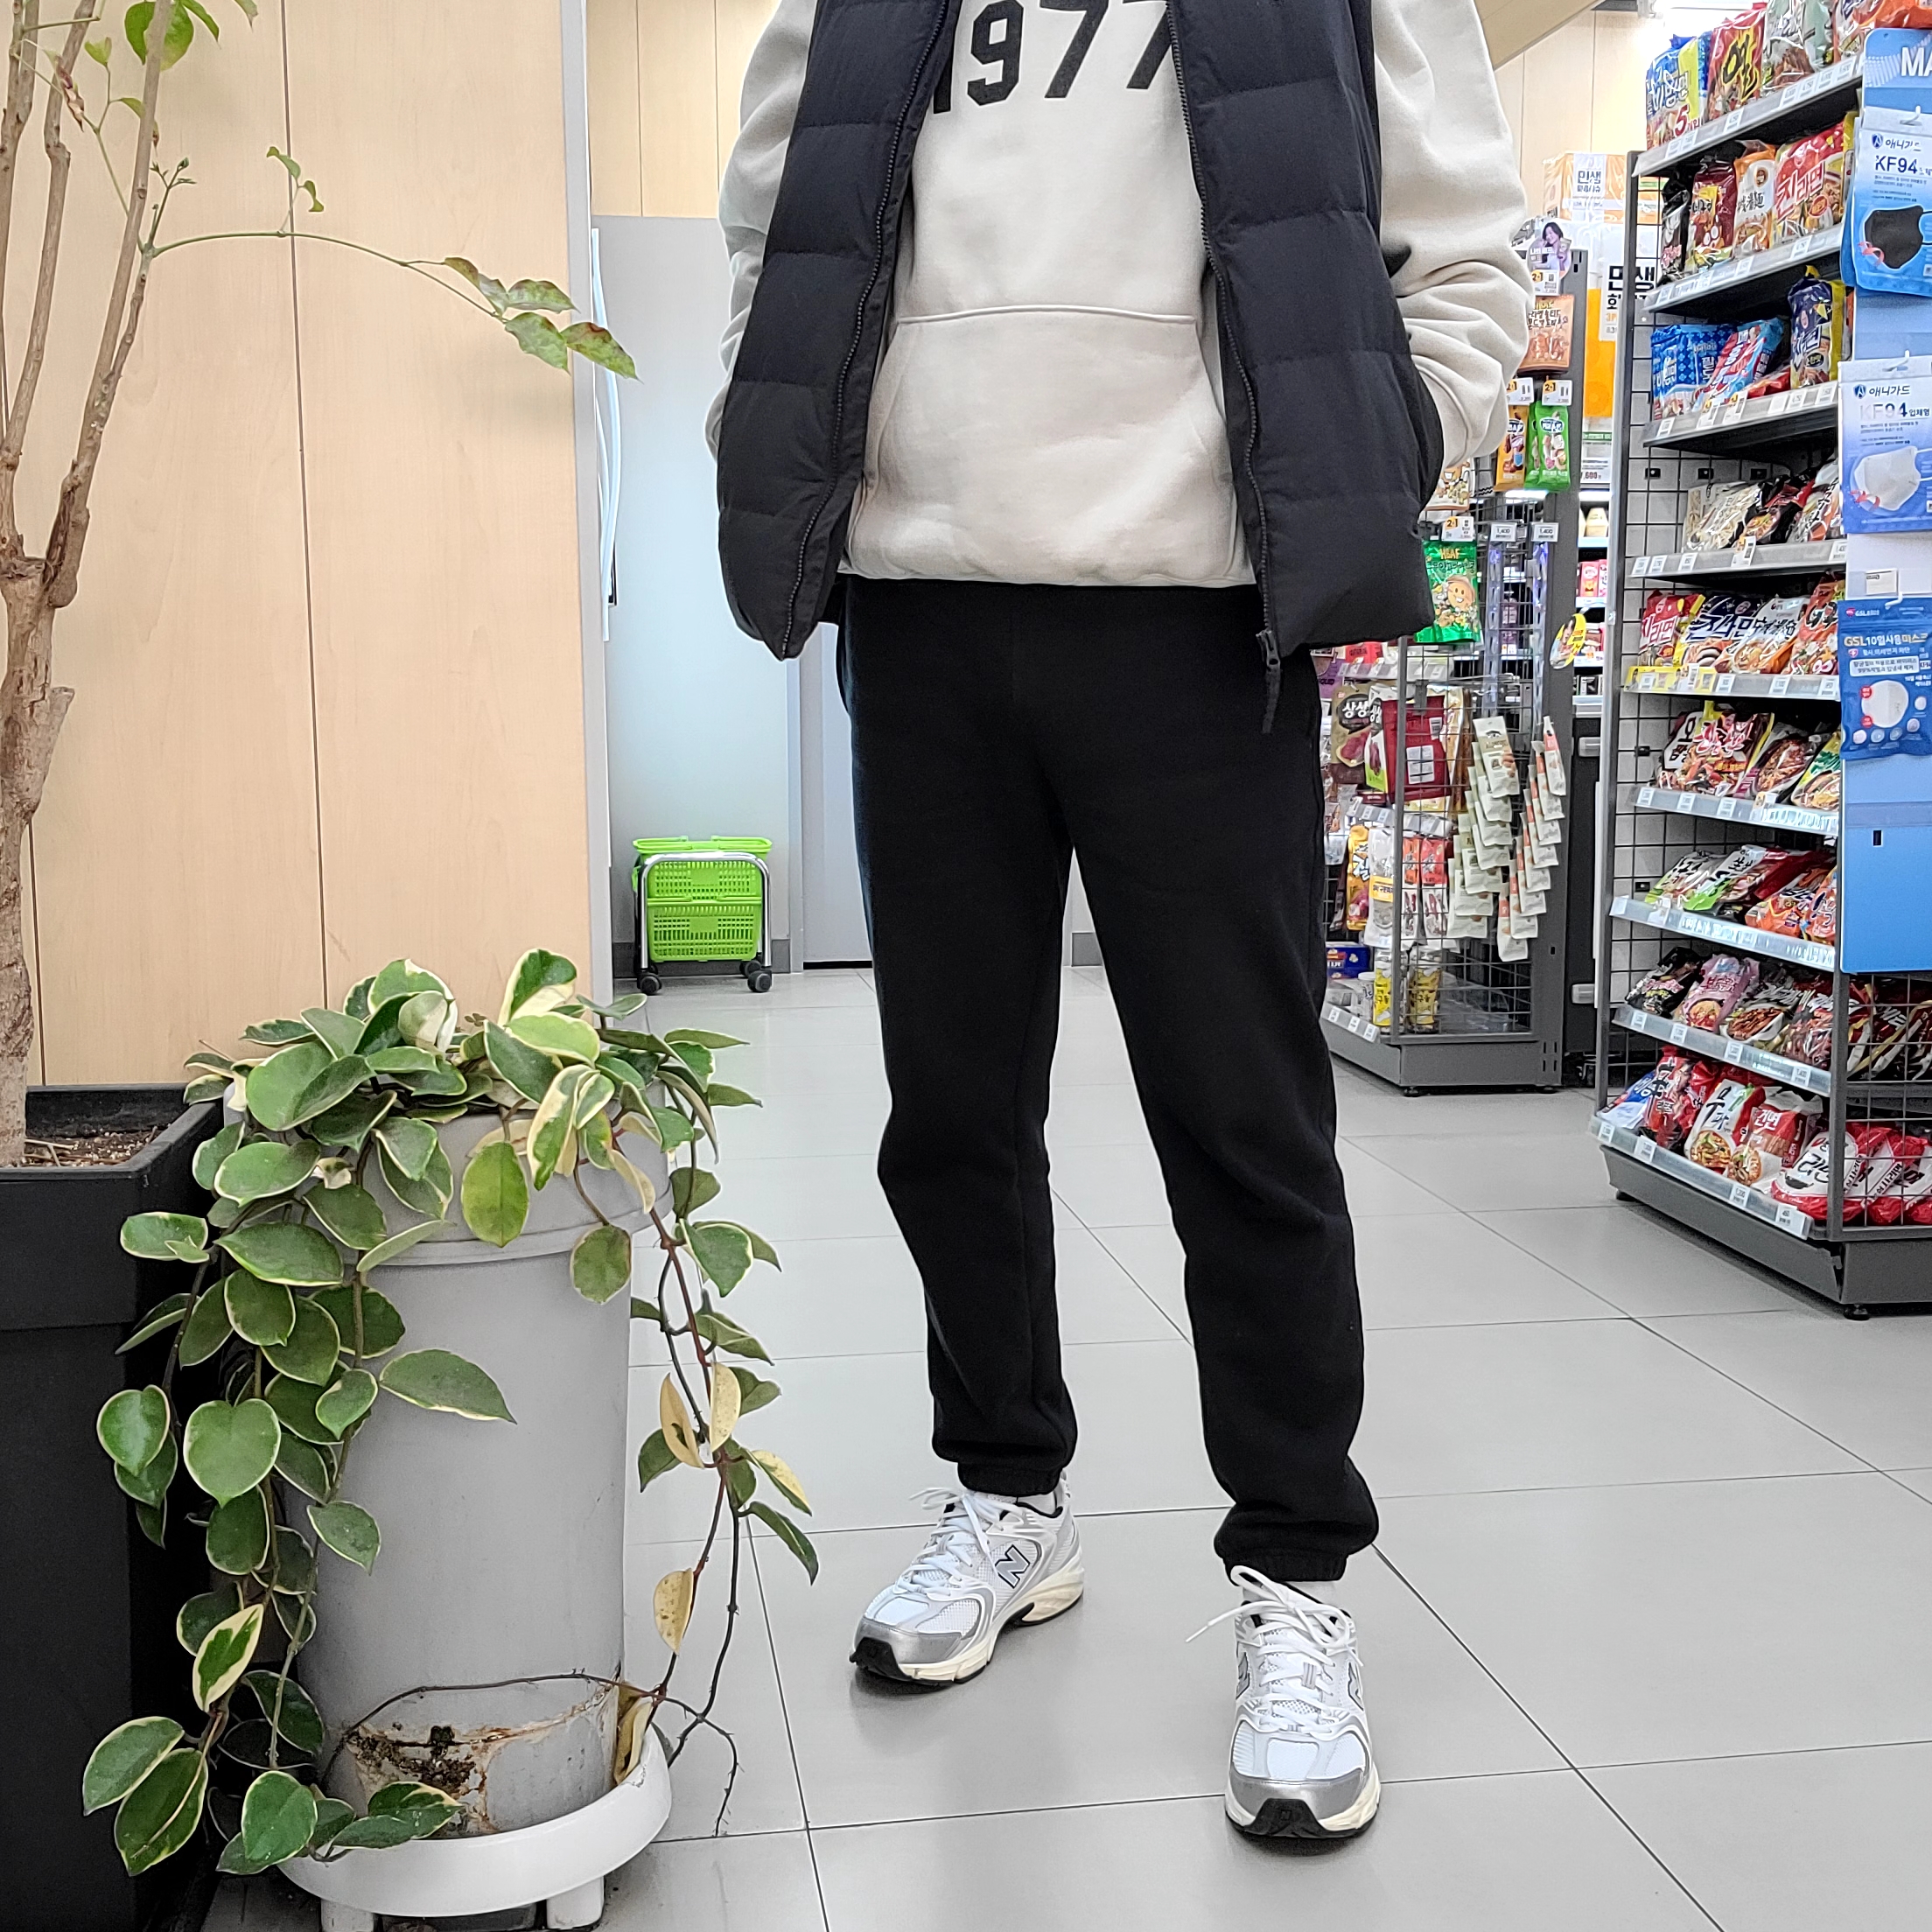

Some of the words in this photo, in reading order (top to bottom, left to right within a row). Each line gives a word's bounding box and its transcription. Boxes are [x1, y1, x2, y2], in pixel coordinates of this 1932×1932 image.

[1874, 154, 1918, 175] KF94
[1578, 170, 1601, 184] 민생
[1776, 161, 1824, 222] 진라면
[1545, 382, 1557, 392] 2+1
[1869, 385, 1910, 397] 애니가드
[1859, 402, 1908, 420] KF94
[1446, 518, 1459, 528] 2+1
[1342, 700, 1369, 718] 상상
[1754, 1109, 1782, 1130] 건면
